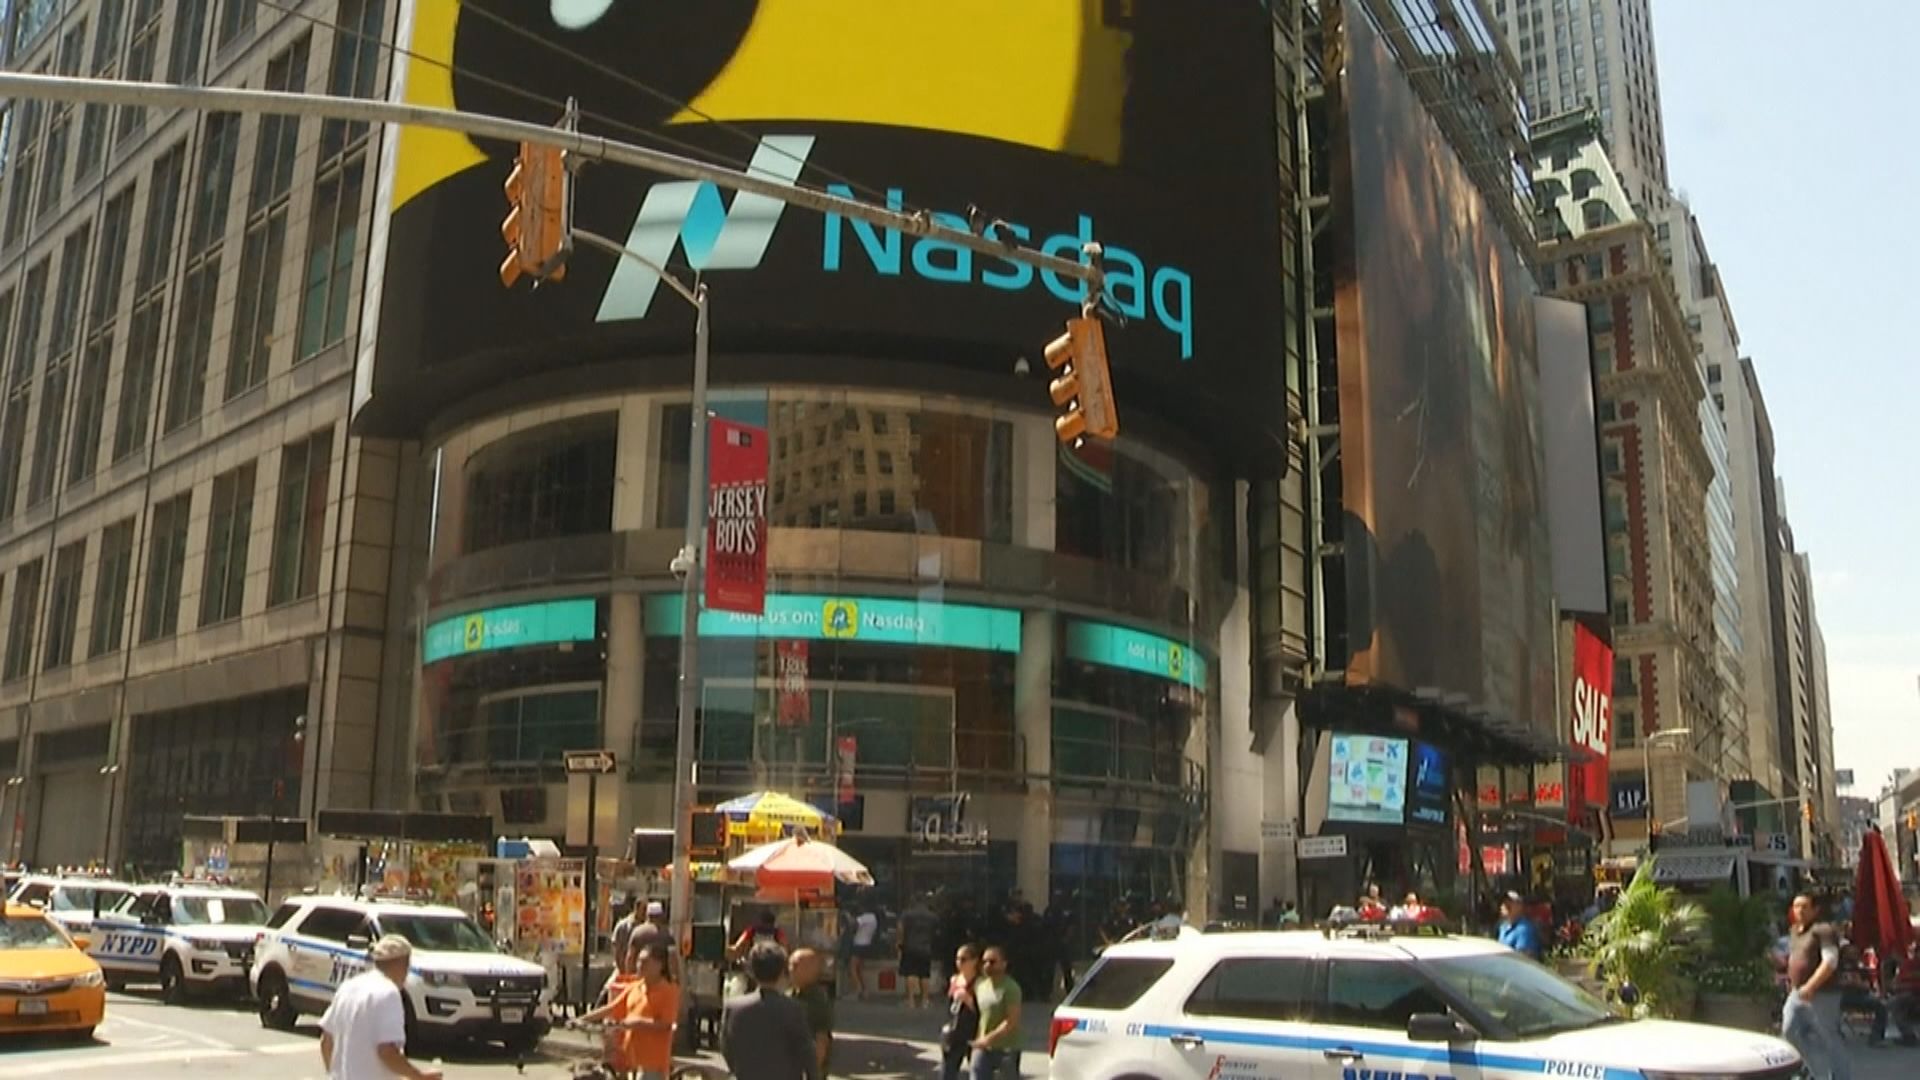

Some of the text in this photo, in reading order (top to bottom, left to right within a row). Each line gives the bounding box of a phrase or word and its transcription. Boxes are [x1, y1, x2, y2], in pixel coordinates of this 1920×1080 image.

[822, 183, 1194, 360] Nasdaq
[708, 485, 767, 520] JERSEY
[715, 518, 758, 555] BOYS
[768, 610, 787, 625] us
[862, 612, 925, 633] Nasdaq
[1573, 676, 1609, 757] SALE
[1618, 790, 1642, 810] GAP
[100, 933, 159, 956] NYPD
[1547, 1059, 1603, 1079] POLICE
